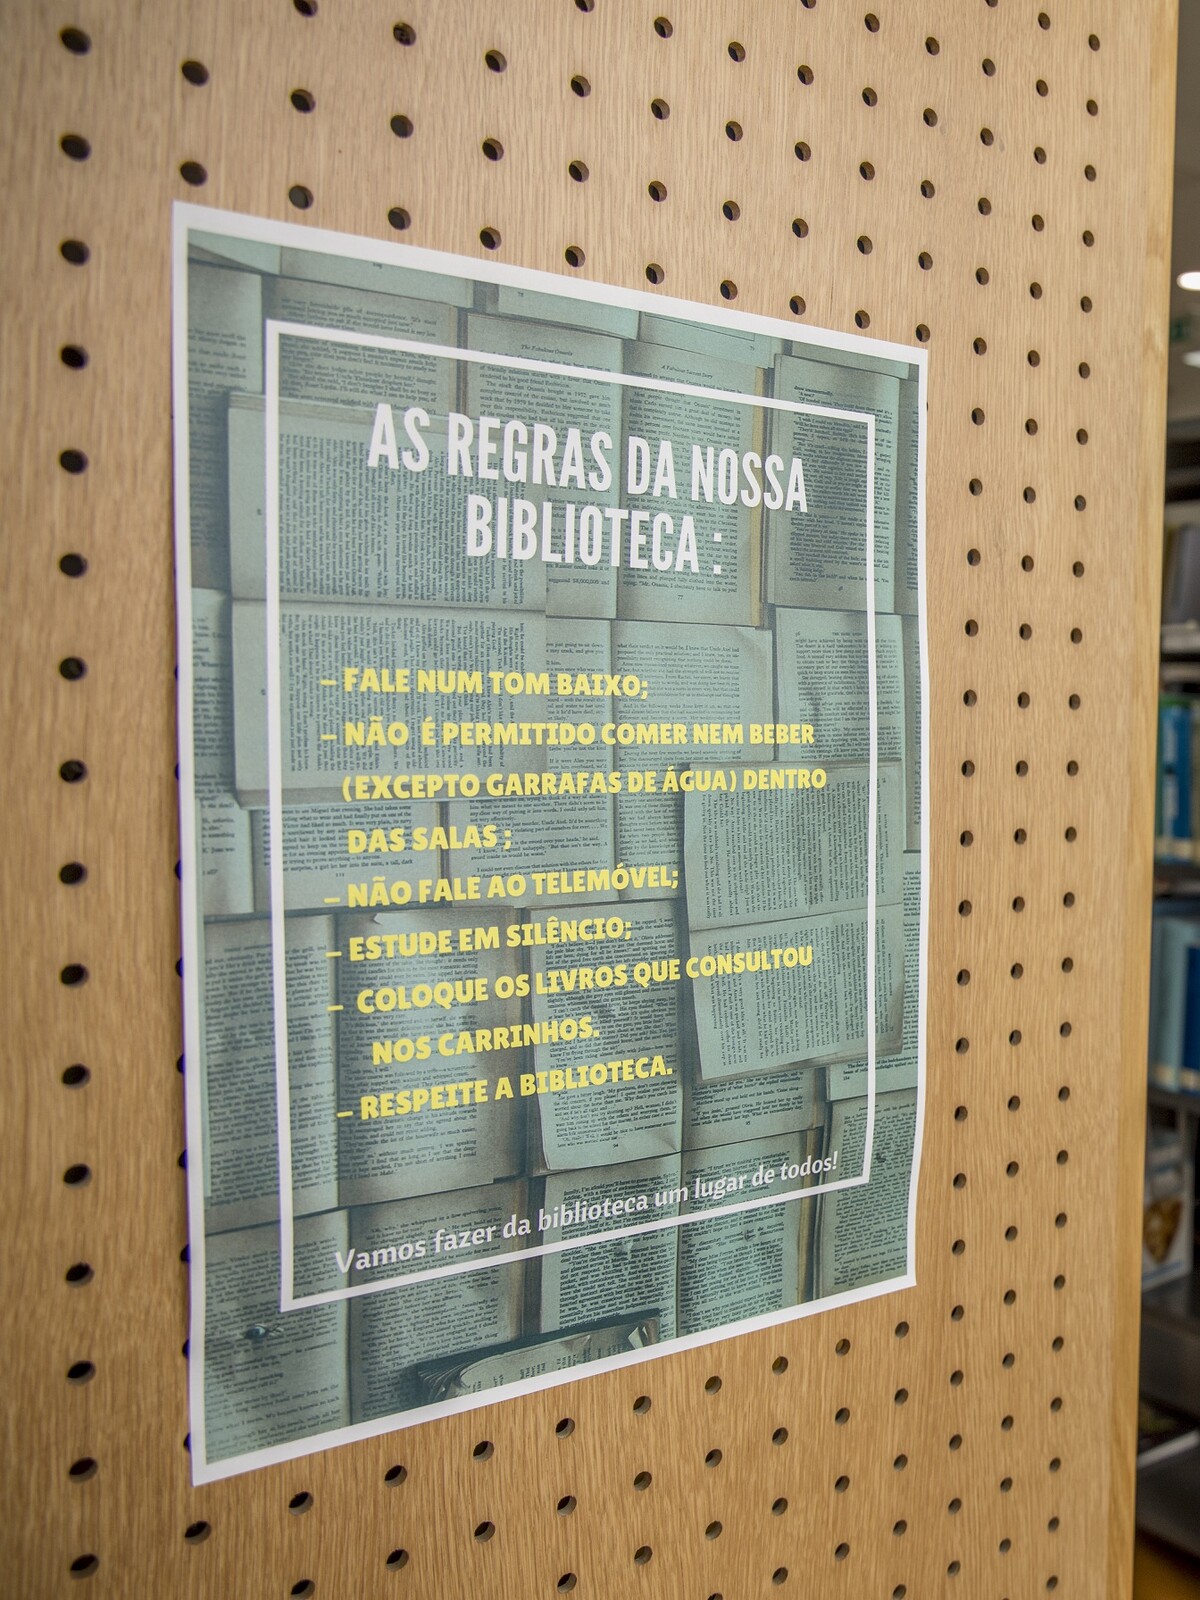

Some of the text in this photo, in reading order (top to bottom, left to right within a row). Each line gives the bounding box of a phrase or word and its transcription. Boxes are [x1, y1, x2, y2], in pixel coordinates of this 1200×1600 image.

[367, 402, 808, 513] AS REGRAS DA NOSSA
[344, 667, 410, 693] FALE
[417, 669, 483, 694] NUM
[489, 671, 550, 695] TOM
[556, 673, 649, 699] BAIXO;
[344, 715, 409, 746] NÃO
[421, 715, 436, 745] É
[442, 722, 596, 745] PERMITIDO
[601, 723, 687, 745] COMER
[693, 723, 744, 744] NEM
[749, 723, 814, 745] BEBER
[341, 765, 827, 801] (EXCEPTO GARRAFAS DE ÁGUA) DENTRO
[347, 828, 405, 854] DAS
[347, 876, 412, 908] NÃO
[418, 876, 481, 903] FALE
[487, 874, 526, 898] AO
[530, 862, 679, 896] TELEMÓVEL;
[349, 930, 452, 962] ESTUDE
[458, 926, 501, 952] EM
[506, 915, 632, 948] SILÊNCIO;
[356, 977, 488, 1014] COLOQUE
[493, 973, 531, 999] OS
[535, 964, 628, 995] LIVROS
[633, 959, 681, 988] QUE
[685, 946, 813, 979] CONSULTOU
[372, 1016, 600, 1066] NOS CARRINHOS.
[360, 1079, 489, 1121] RESPEITE
[494, 1076, 513, 1101] A
[519, 1055, 674, 1098] BIBLIOTECA.
[335, 1150, 838, 1274] Vamos fazer da biblioteca um lugar de todos!
